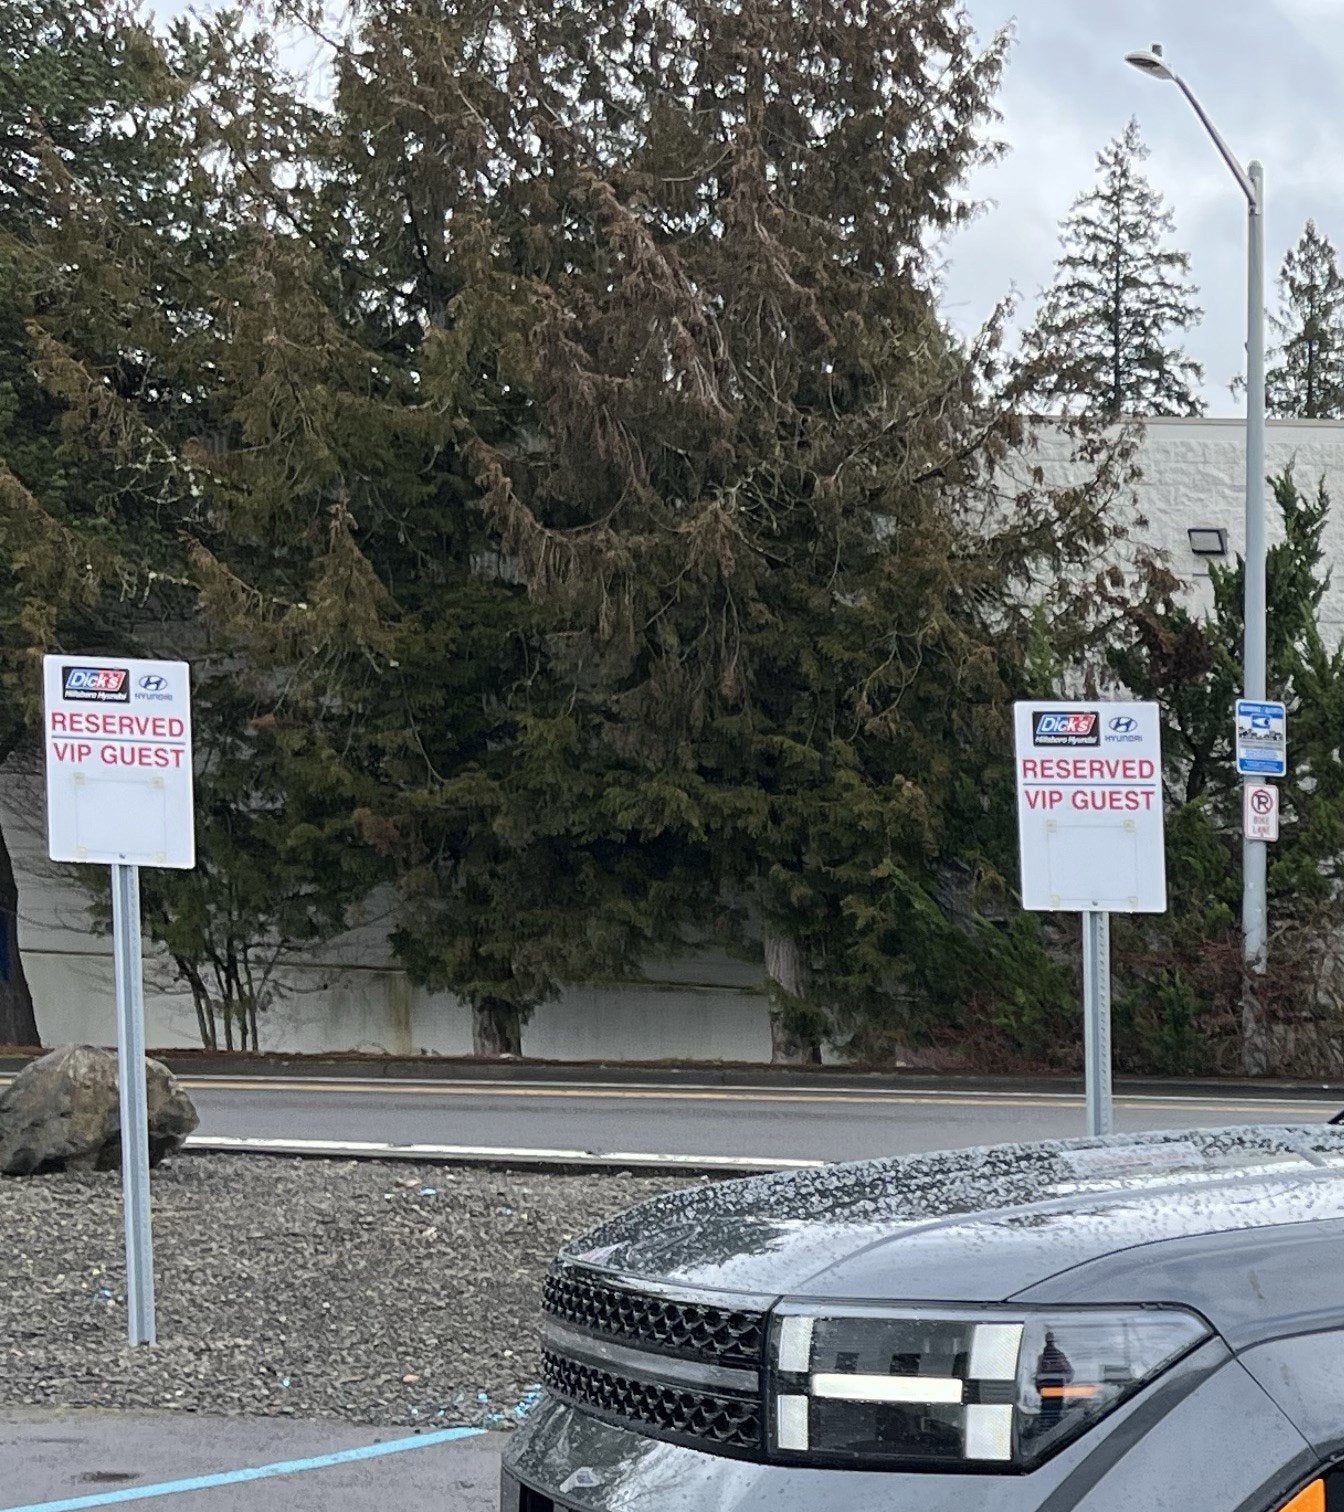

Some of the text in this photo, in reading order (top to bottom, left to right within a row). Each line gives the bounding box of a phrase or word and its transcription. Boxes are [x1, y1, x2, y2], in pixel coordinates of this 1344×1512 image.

[51, 711, 184, 738] RESERVED
[53, 743, 185, 768] VIP GUEST
[1022, 759, 1155, 779] RESERVED
[1024, 790, 1155, 810] VIP GUEST
